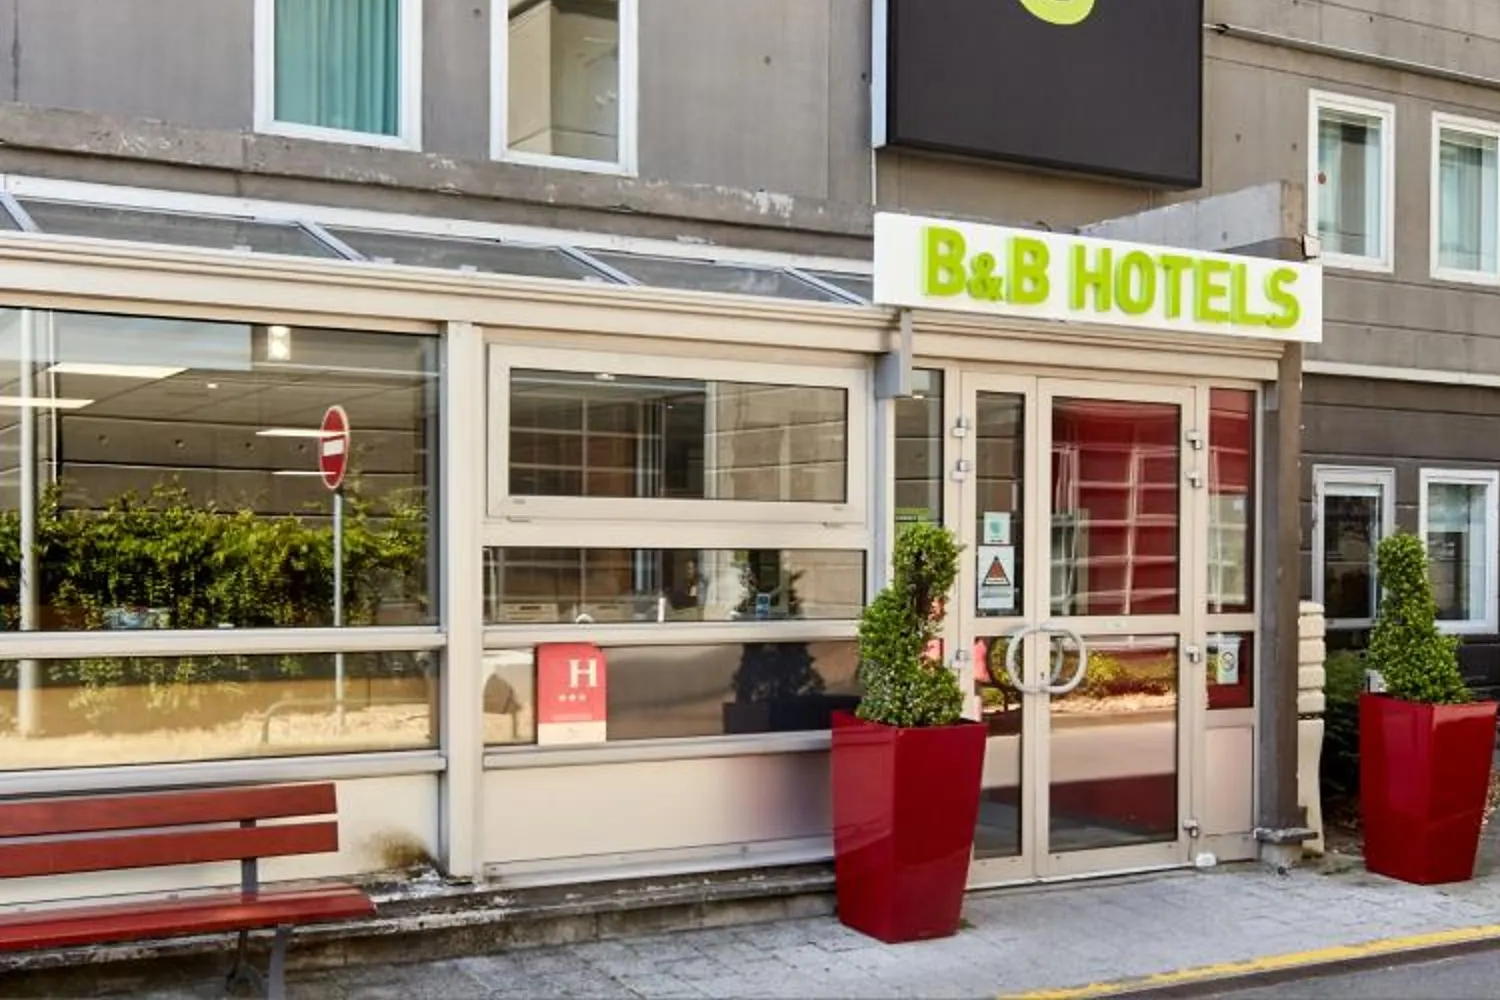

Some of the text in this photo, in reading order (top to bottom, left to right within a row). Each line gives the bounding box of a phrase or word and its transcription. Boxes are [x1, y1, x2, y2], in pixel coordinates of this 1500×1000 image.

[922, 226, 1302, 329] B&B HOTELS
[568, 658, 598, 689] H
